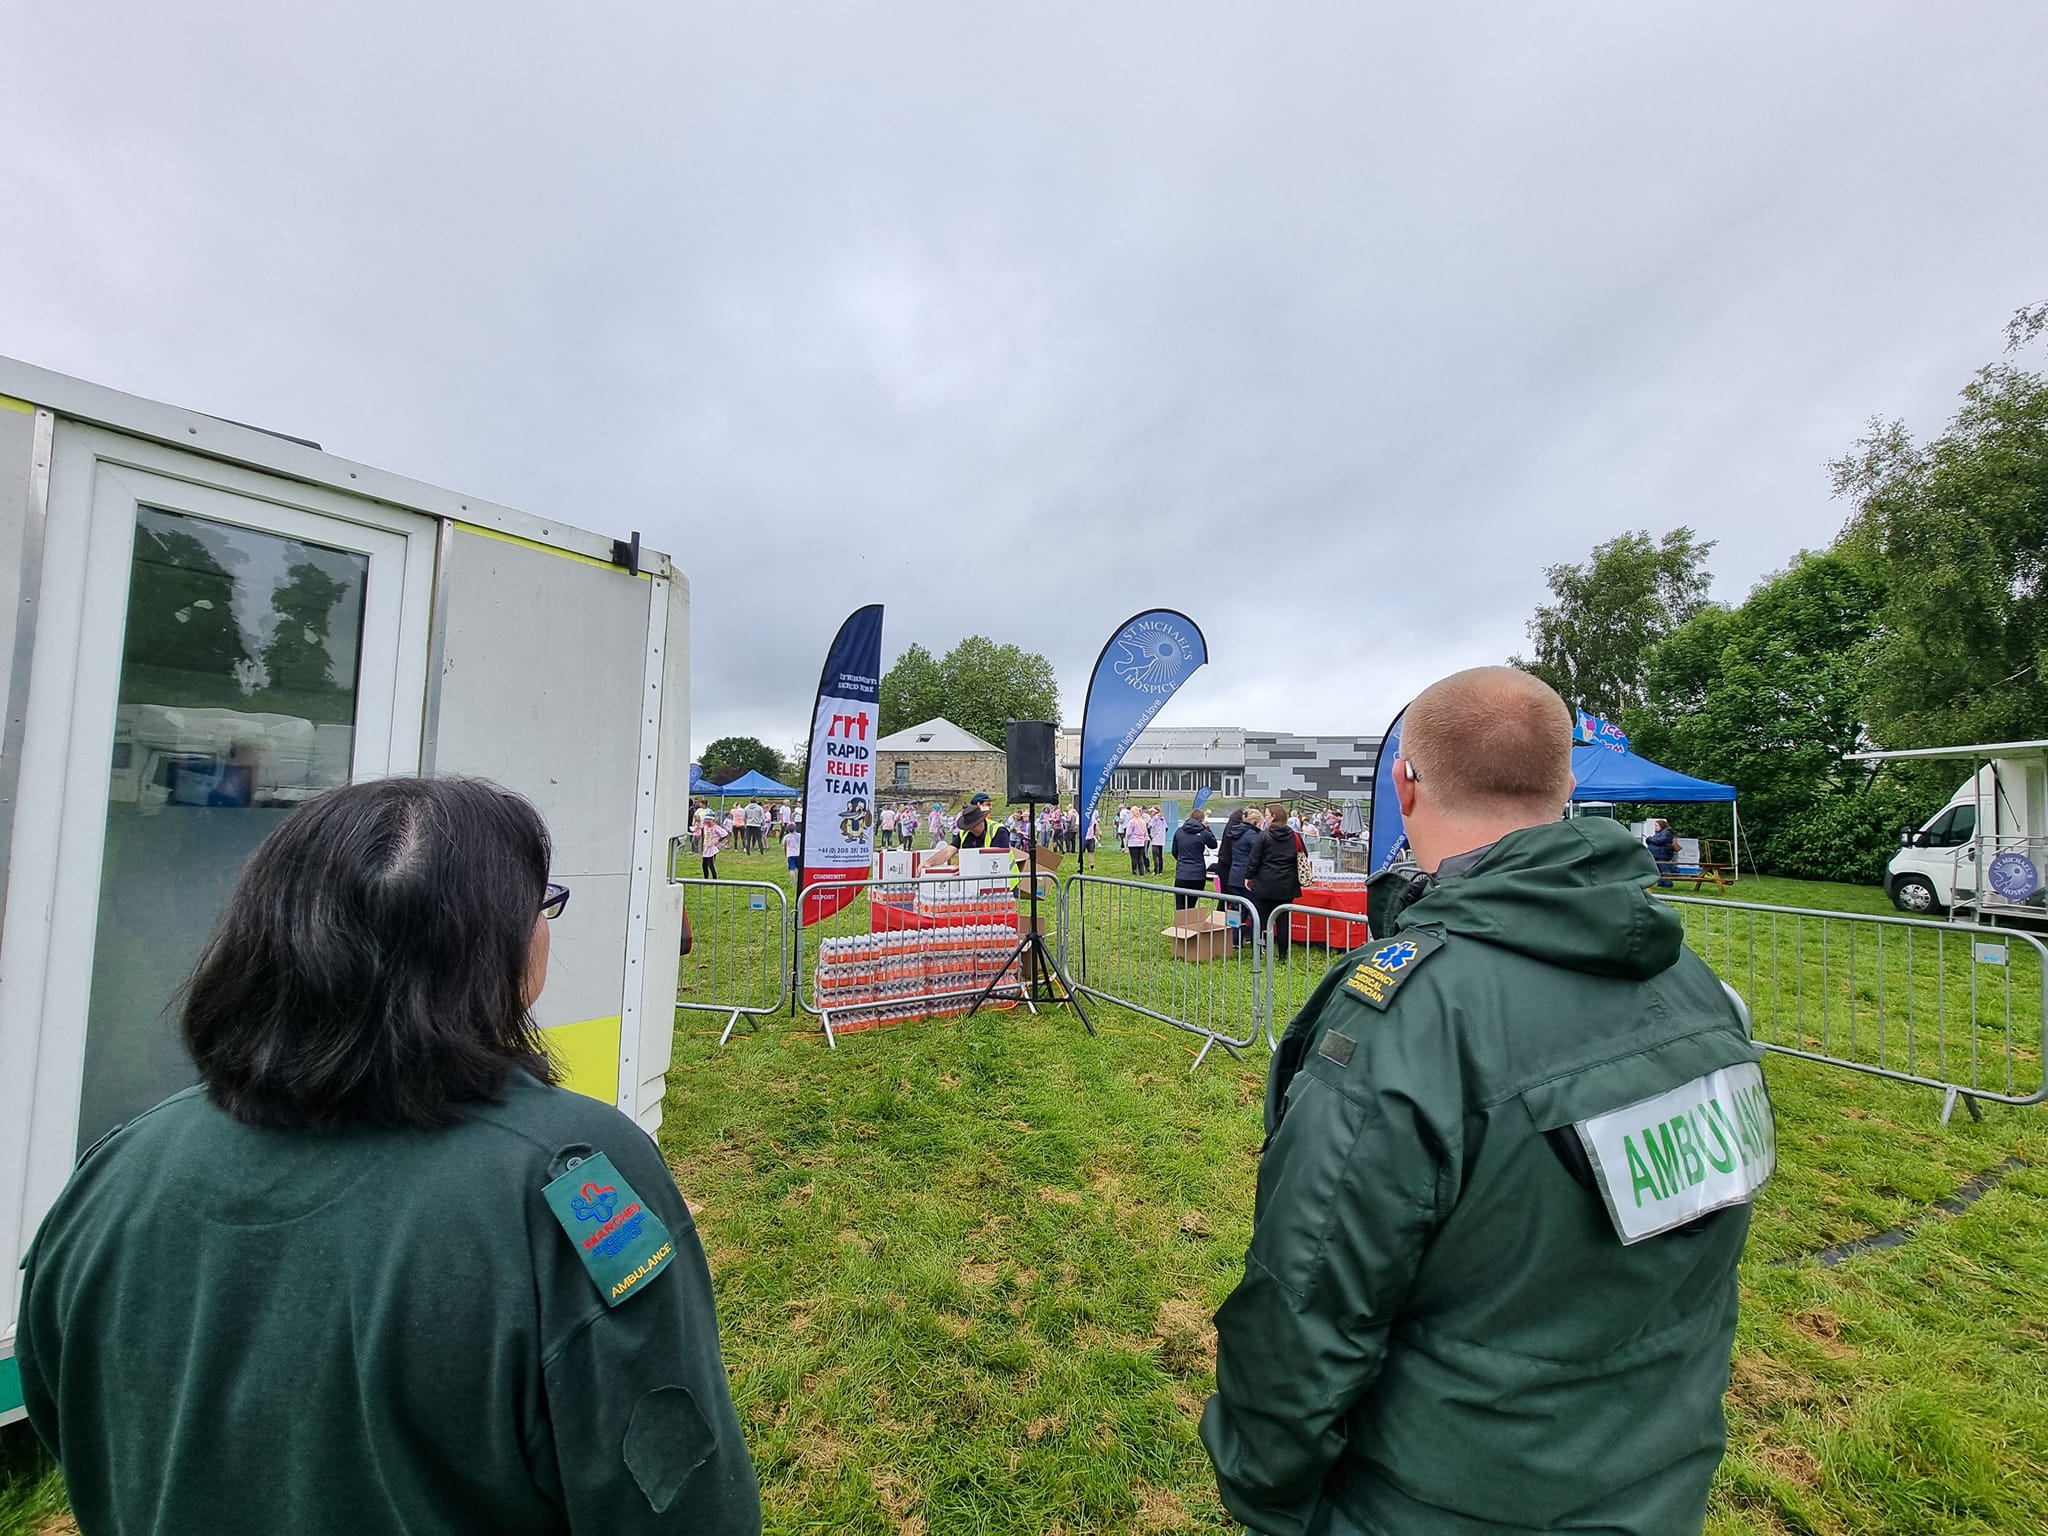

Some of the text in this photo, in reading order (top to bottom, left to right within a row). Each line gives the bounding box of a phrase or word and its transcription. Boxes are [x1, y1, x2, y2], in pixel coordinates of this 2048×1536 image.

[1122, 626, 1138, 641] ST
[1124, 674, 1179, 694] HOSPICE
[828, 712, 869, 740] rrt
[827, 742, 869, 760] RAPID
[1085, 698, 1162, 819] Always a place of light and love
[827, 760, 869, 777] RELIEF
[825, 779, 868, 795] TEAM
[1354, 972, 1382, 991] MEDICAL
[1356, 963, 1397, 987] EMERGENCY
[1347, 978, 1384, 1003] TECHNICIAN
[582, 1202, 641, 1251] MARCHES
[607, 1226, 643, 1258] SERVICE
[611, 1242, 672, 1298] AMBULANCE
